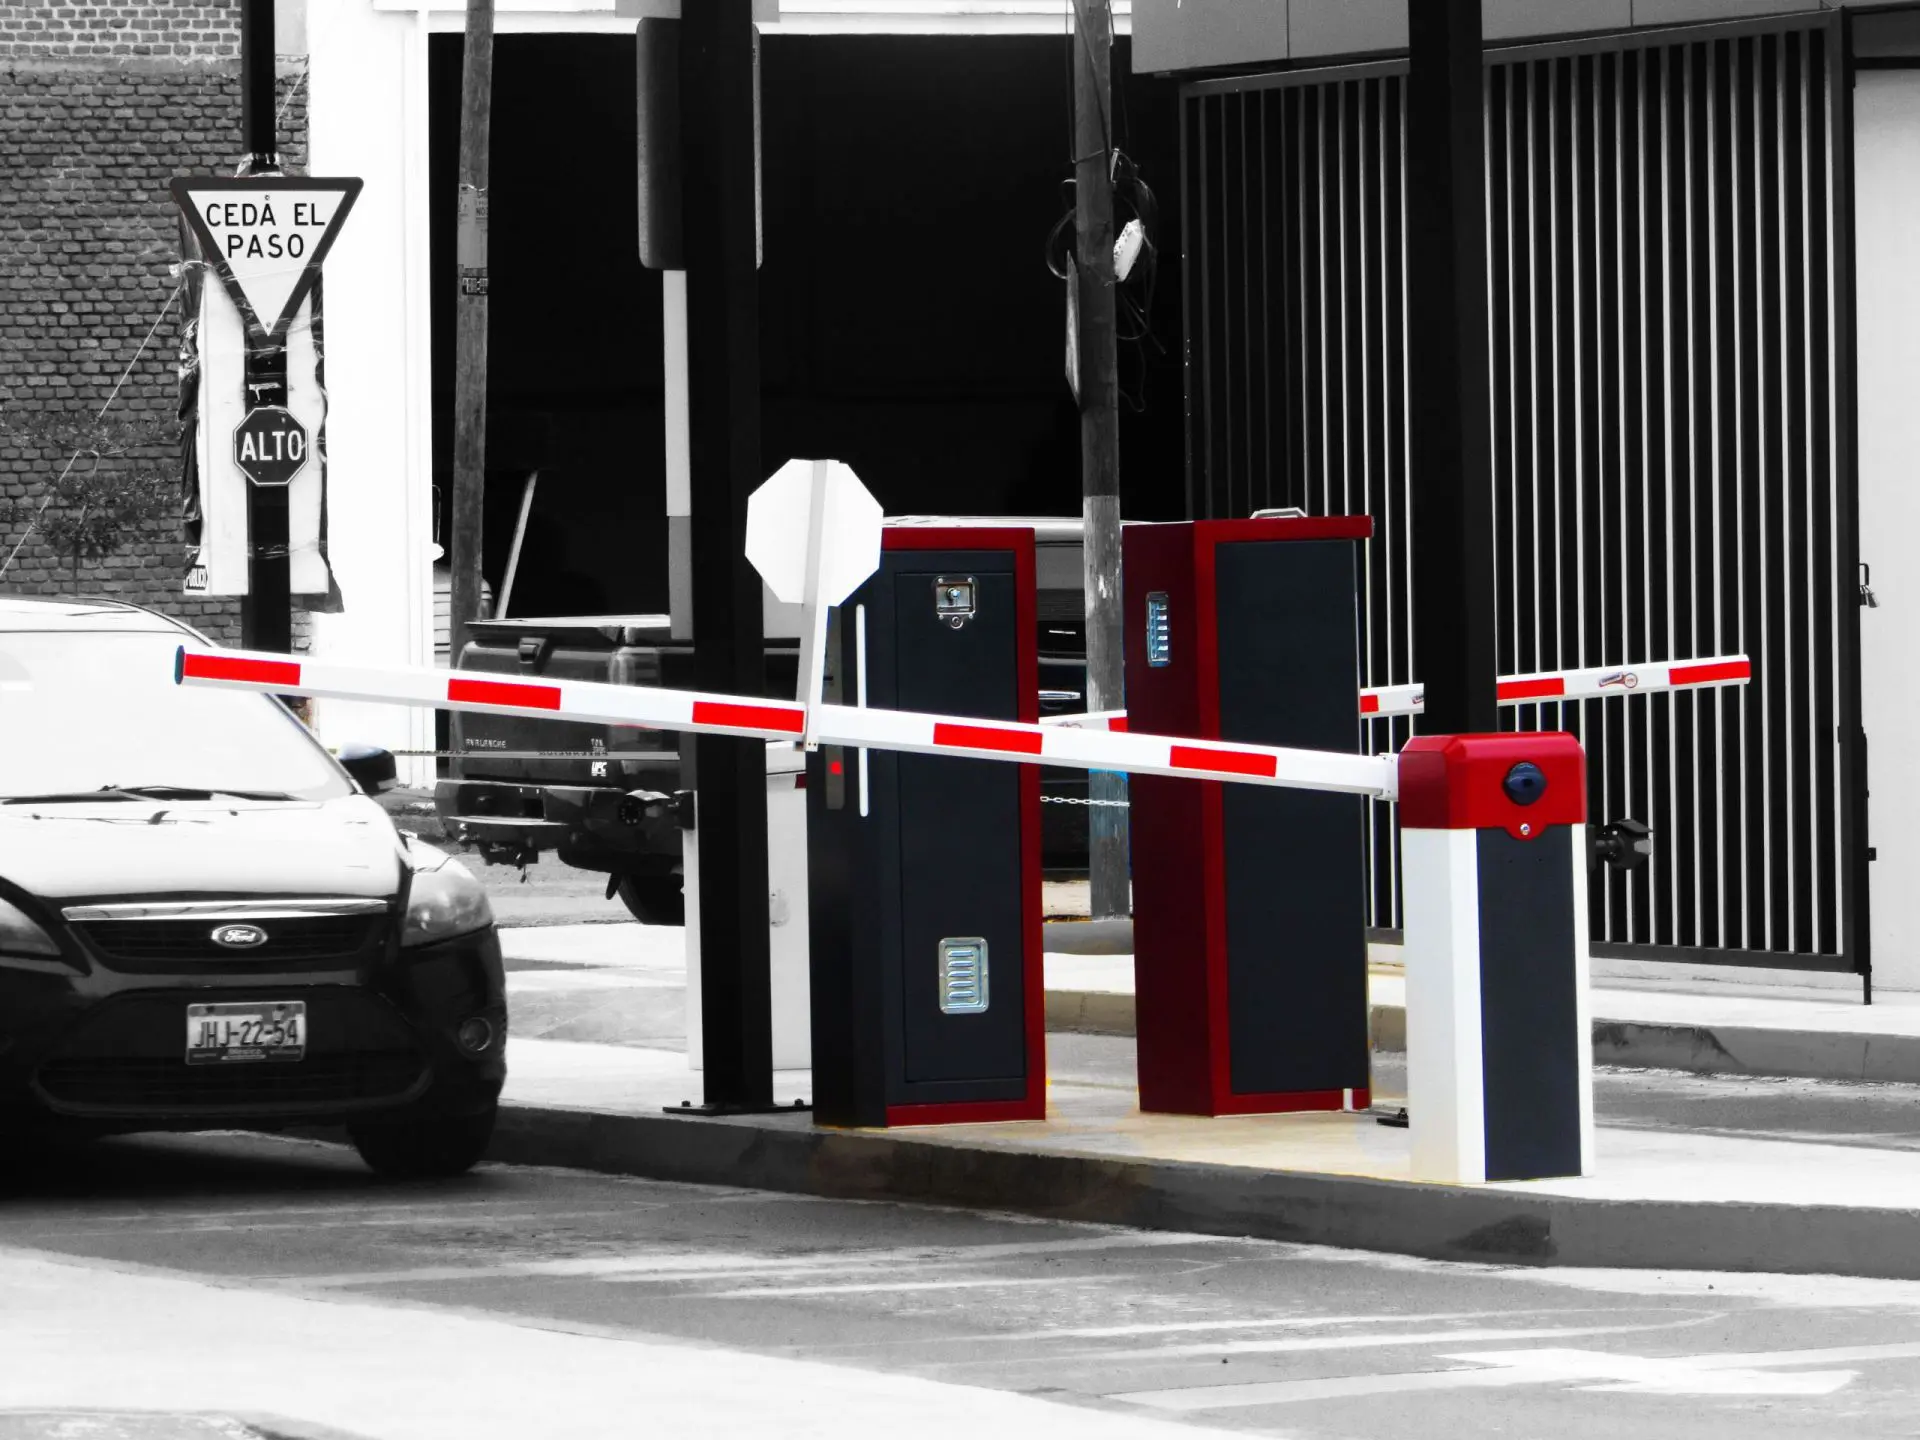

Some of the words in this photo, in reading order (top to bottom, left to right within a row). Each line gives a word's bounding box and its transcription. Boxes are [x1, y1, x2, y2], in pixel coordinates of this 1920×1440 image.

[206, 202, 276, 227] CEDA
[294, 203, 326, 226] EL
[227, 233, 304, 259] PASO
[240, 430, 303, 462] ALTO
[224, 929, 257, 943] Ford
[194, 1019, 298, 1047] JHJ-22-54
